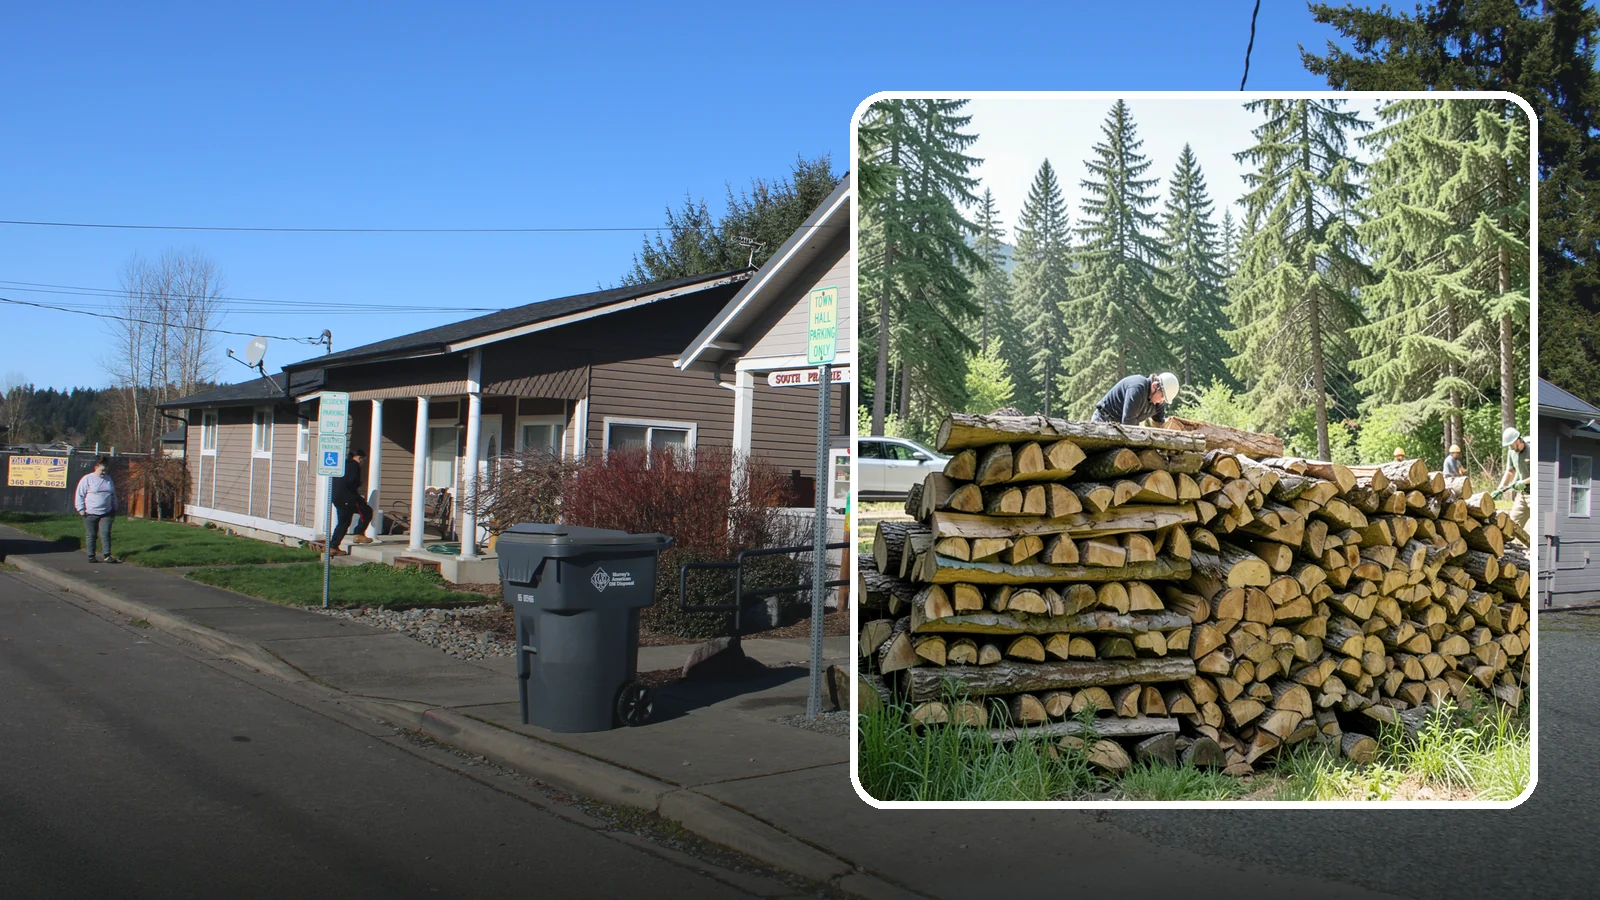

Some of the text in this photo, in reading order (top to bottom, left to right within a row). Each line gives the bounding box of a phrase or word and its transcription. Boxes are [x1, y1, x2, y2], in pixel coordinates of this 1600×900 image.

[815, 295, 832, 307] TOWN
[814, 312, 831, 324] HALL
[810, 327, 836, 340] PARKING
[813, 344, 830, 357] ONLY
[775, 374, 801, 384] SOUTH
